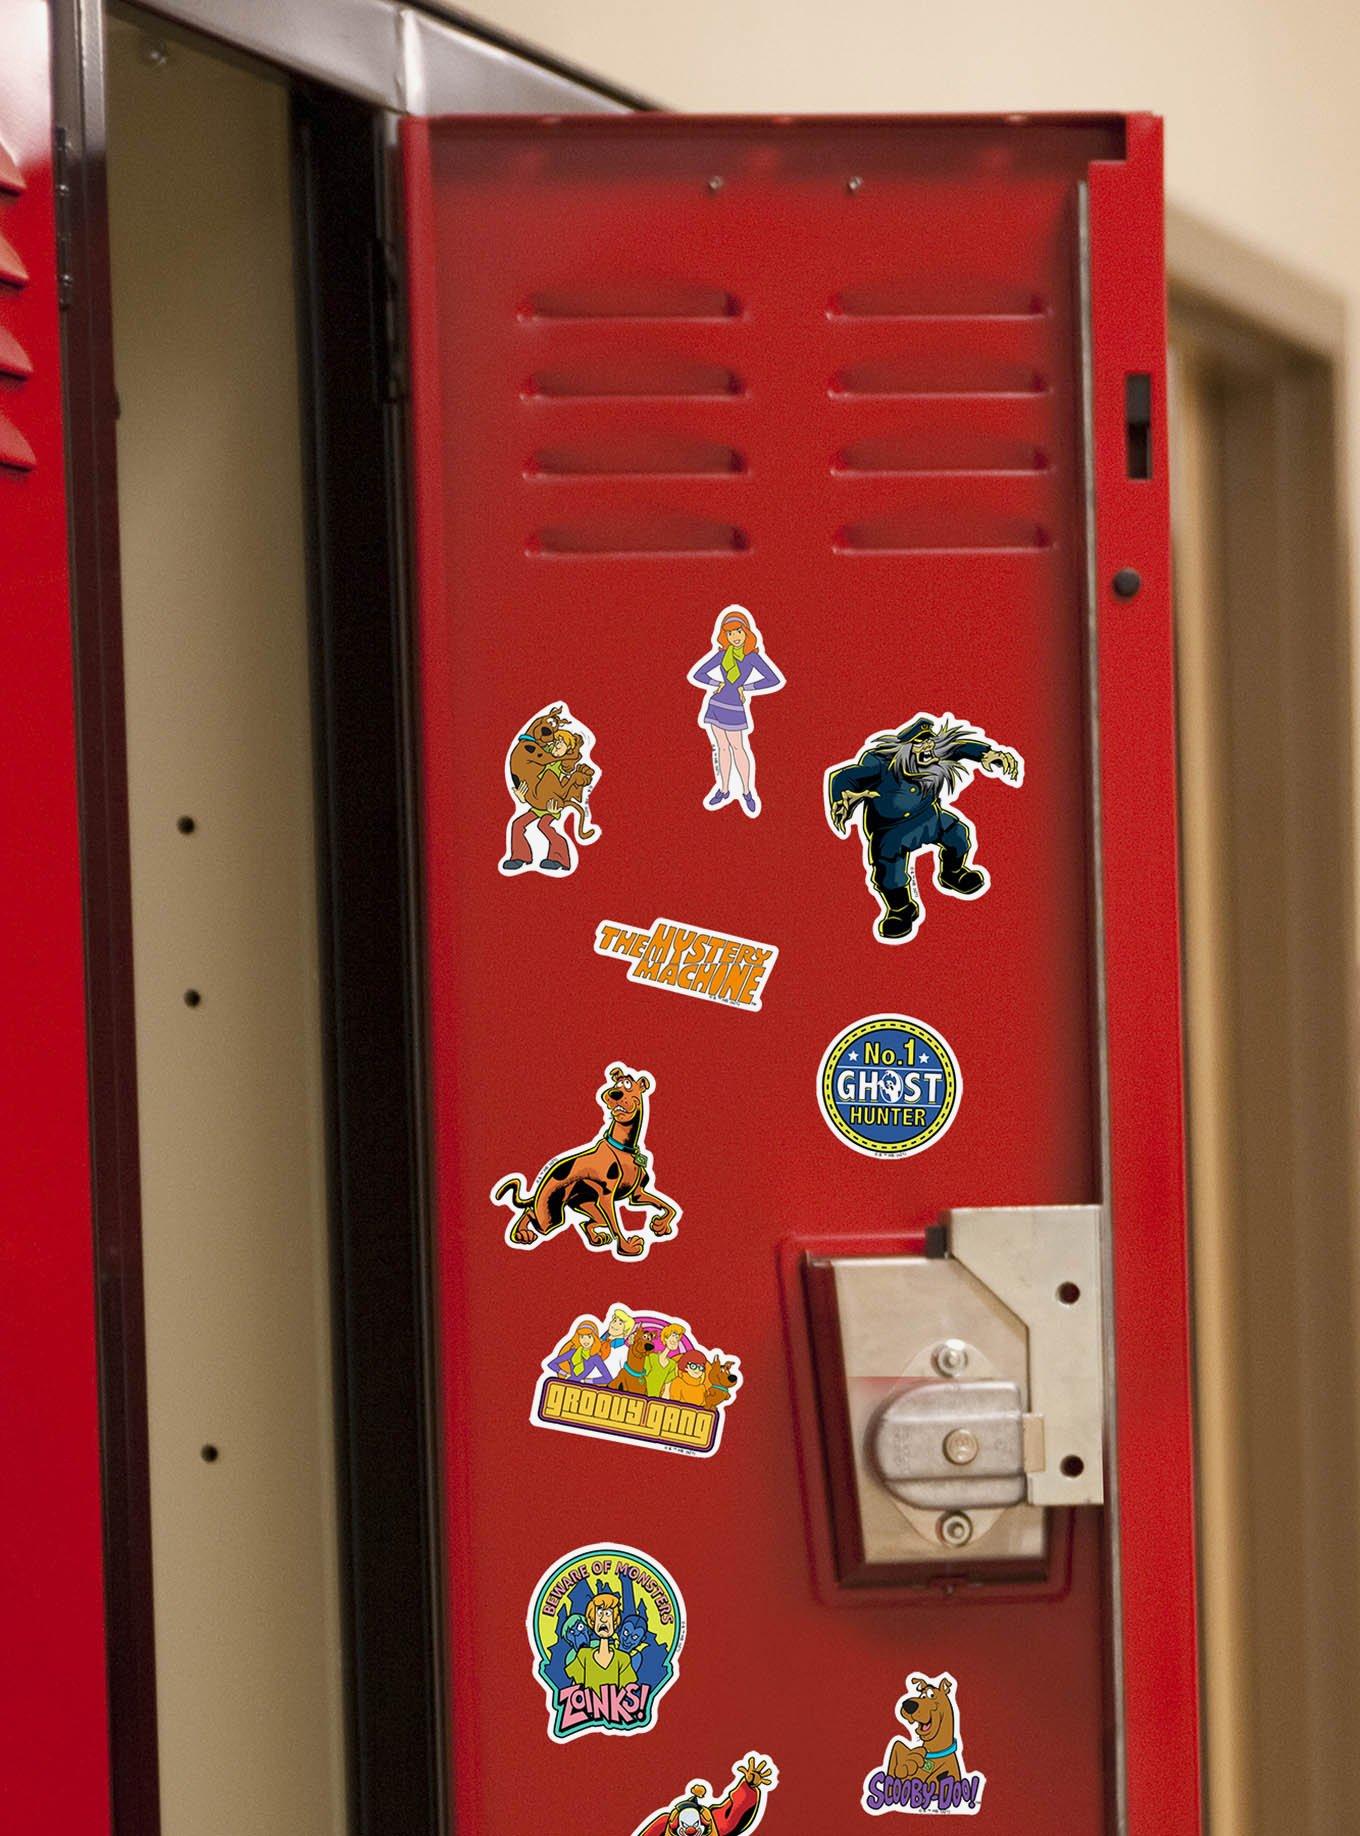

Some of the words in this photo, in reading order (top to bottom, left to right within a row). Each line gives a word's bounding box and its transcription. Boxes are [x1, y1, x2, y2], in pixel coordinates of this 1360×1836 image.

[599, 926, 650, 958] THE
[644, 923, 773, 966] MYSTERY
[633, 955, 767, 1004] MACHINE
[864, 1038, 915, 1066] No.1
[837, 1068, 943, 1104] GHOST
[850, 1106, 926, 1126] HUNTER
[542, 1565, 589, 1617] BEWARE
[592, 1560, 612, 1575] OF
[614, 1561, 674, 1625] MONSTERS
[559, 1683, 650, 1730] ZOINKS!
[866, 1771, 980, 1810] SCOOBY-DOO!
